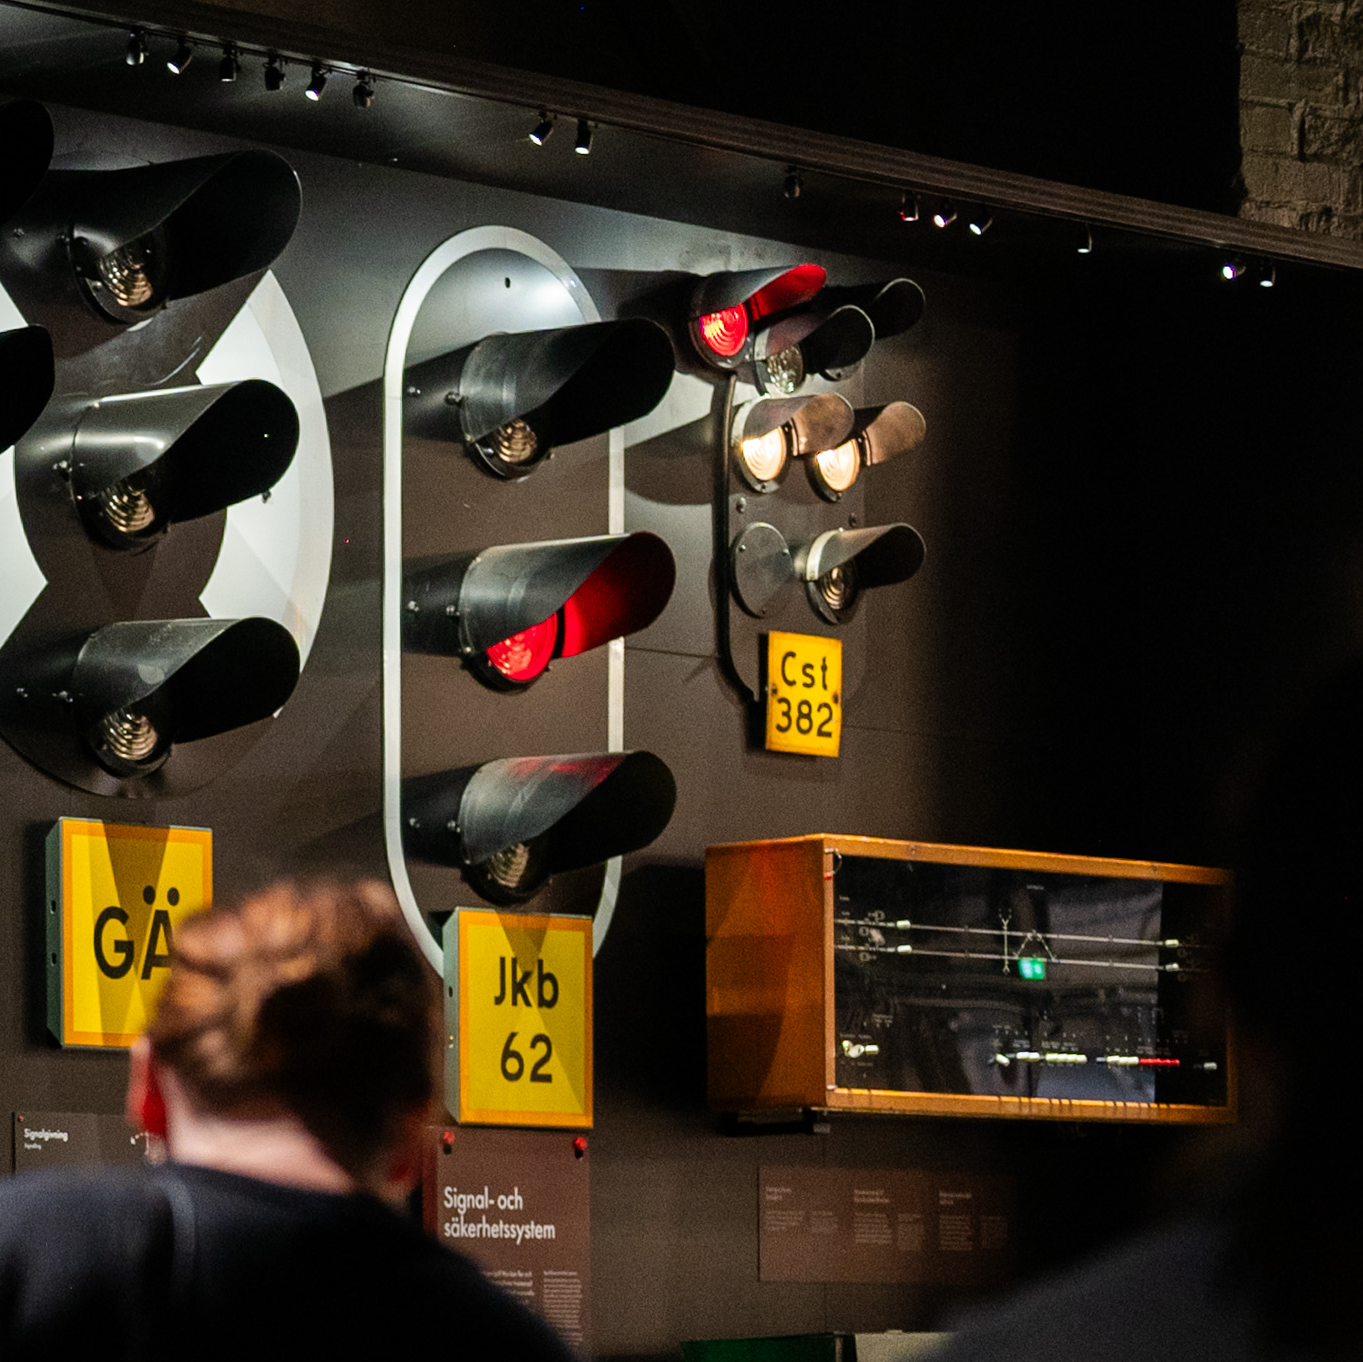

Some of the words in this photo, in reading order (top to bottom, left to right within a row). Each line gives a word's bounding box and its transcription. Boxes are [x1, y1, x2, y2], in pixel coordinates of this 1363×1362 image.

[780, 651, 829, 691] Cst
[776, 698, 834, 738] 382
[93, 885, 180, 980] GÄ
[494, 956, 559, 1010] Jkb
[500, 1033, 553, 1084] 62
[444, 1185, 495, 1214] Signal-
[497, 1186, 523, 1210] och
[444, 1215, 556, 1245] säkerhetssystem
